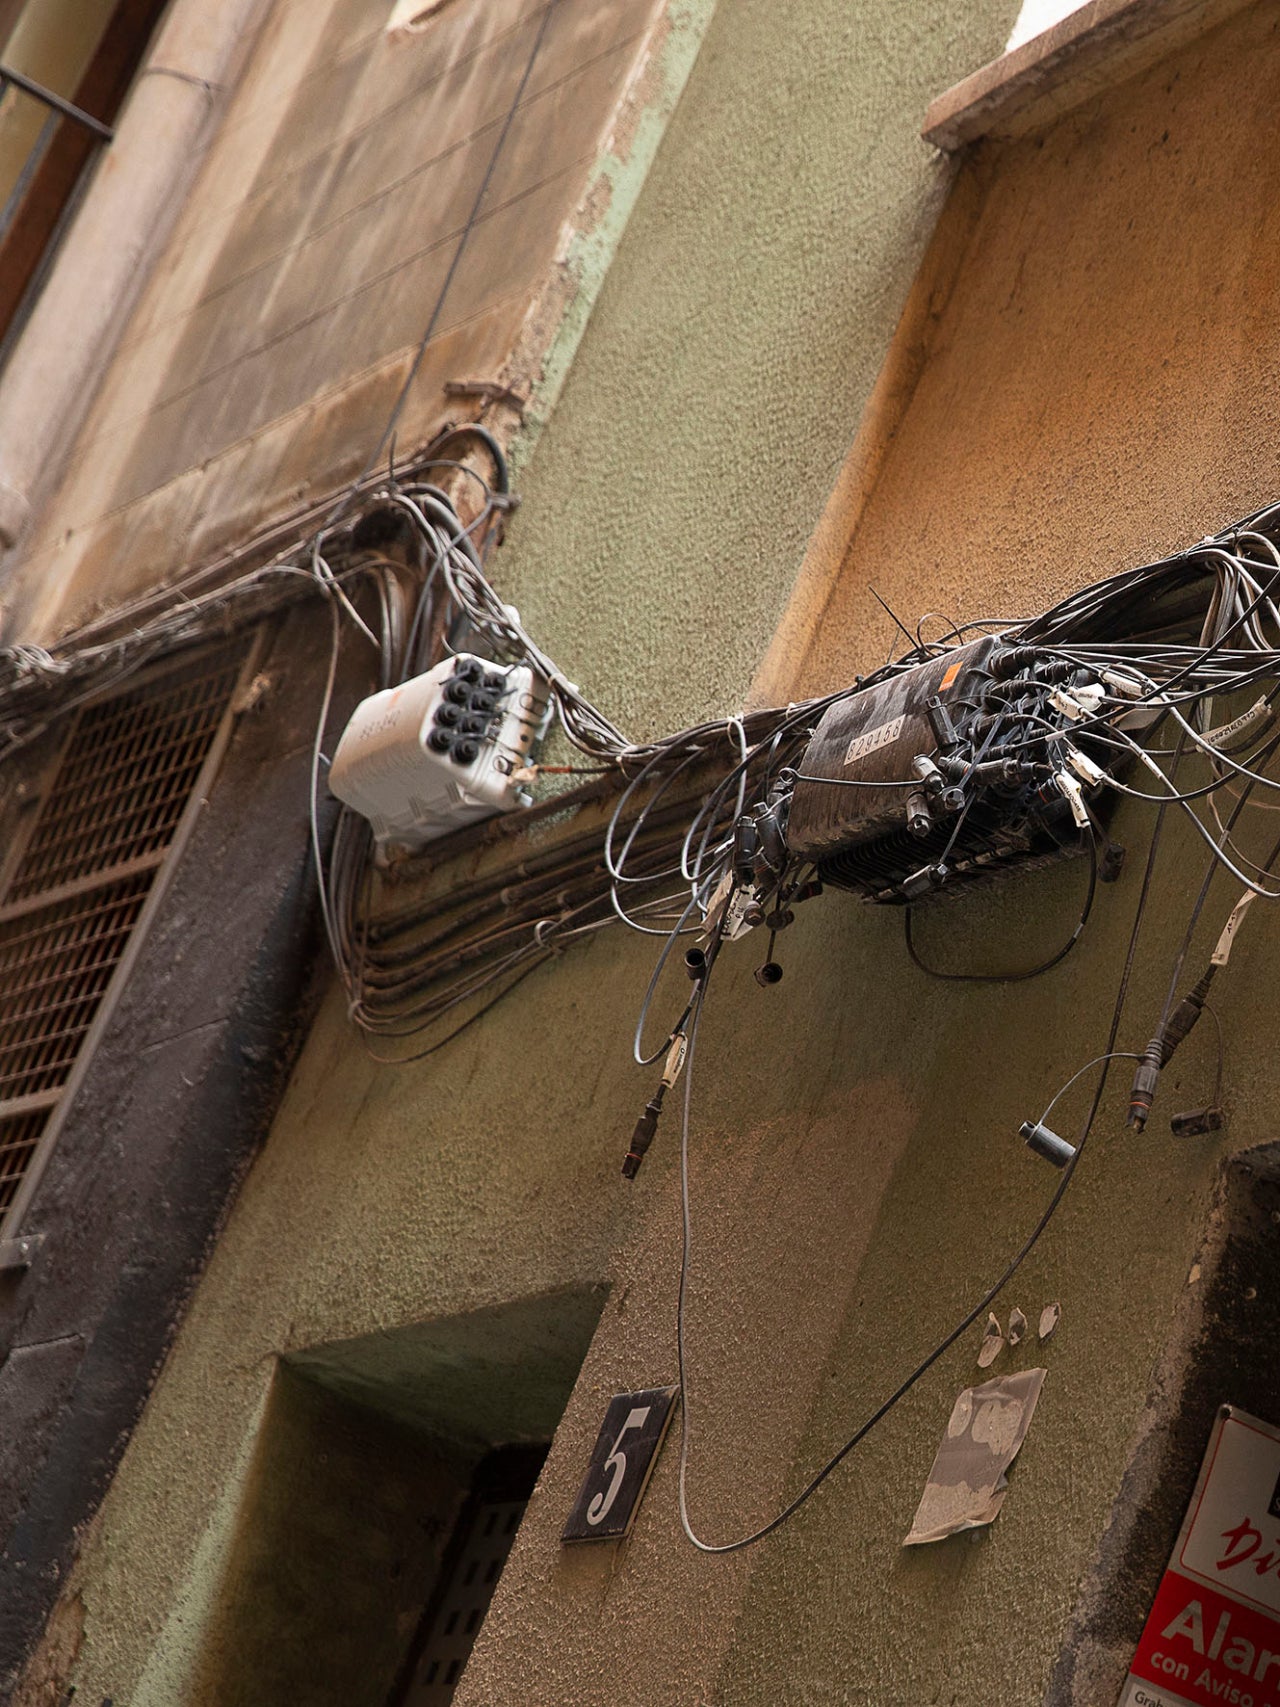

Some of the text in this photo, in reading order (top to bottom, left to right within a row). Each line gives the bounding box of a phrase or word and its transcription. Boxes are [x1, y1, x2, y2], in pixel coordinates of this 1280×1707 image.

[586, 1406, 651, 1527] 5
[1150, 1651, 1254, 1707] con Aviso
